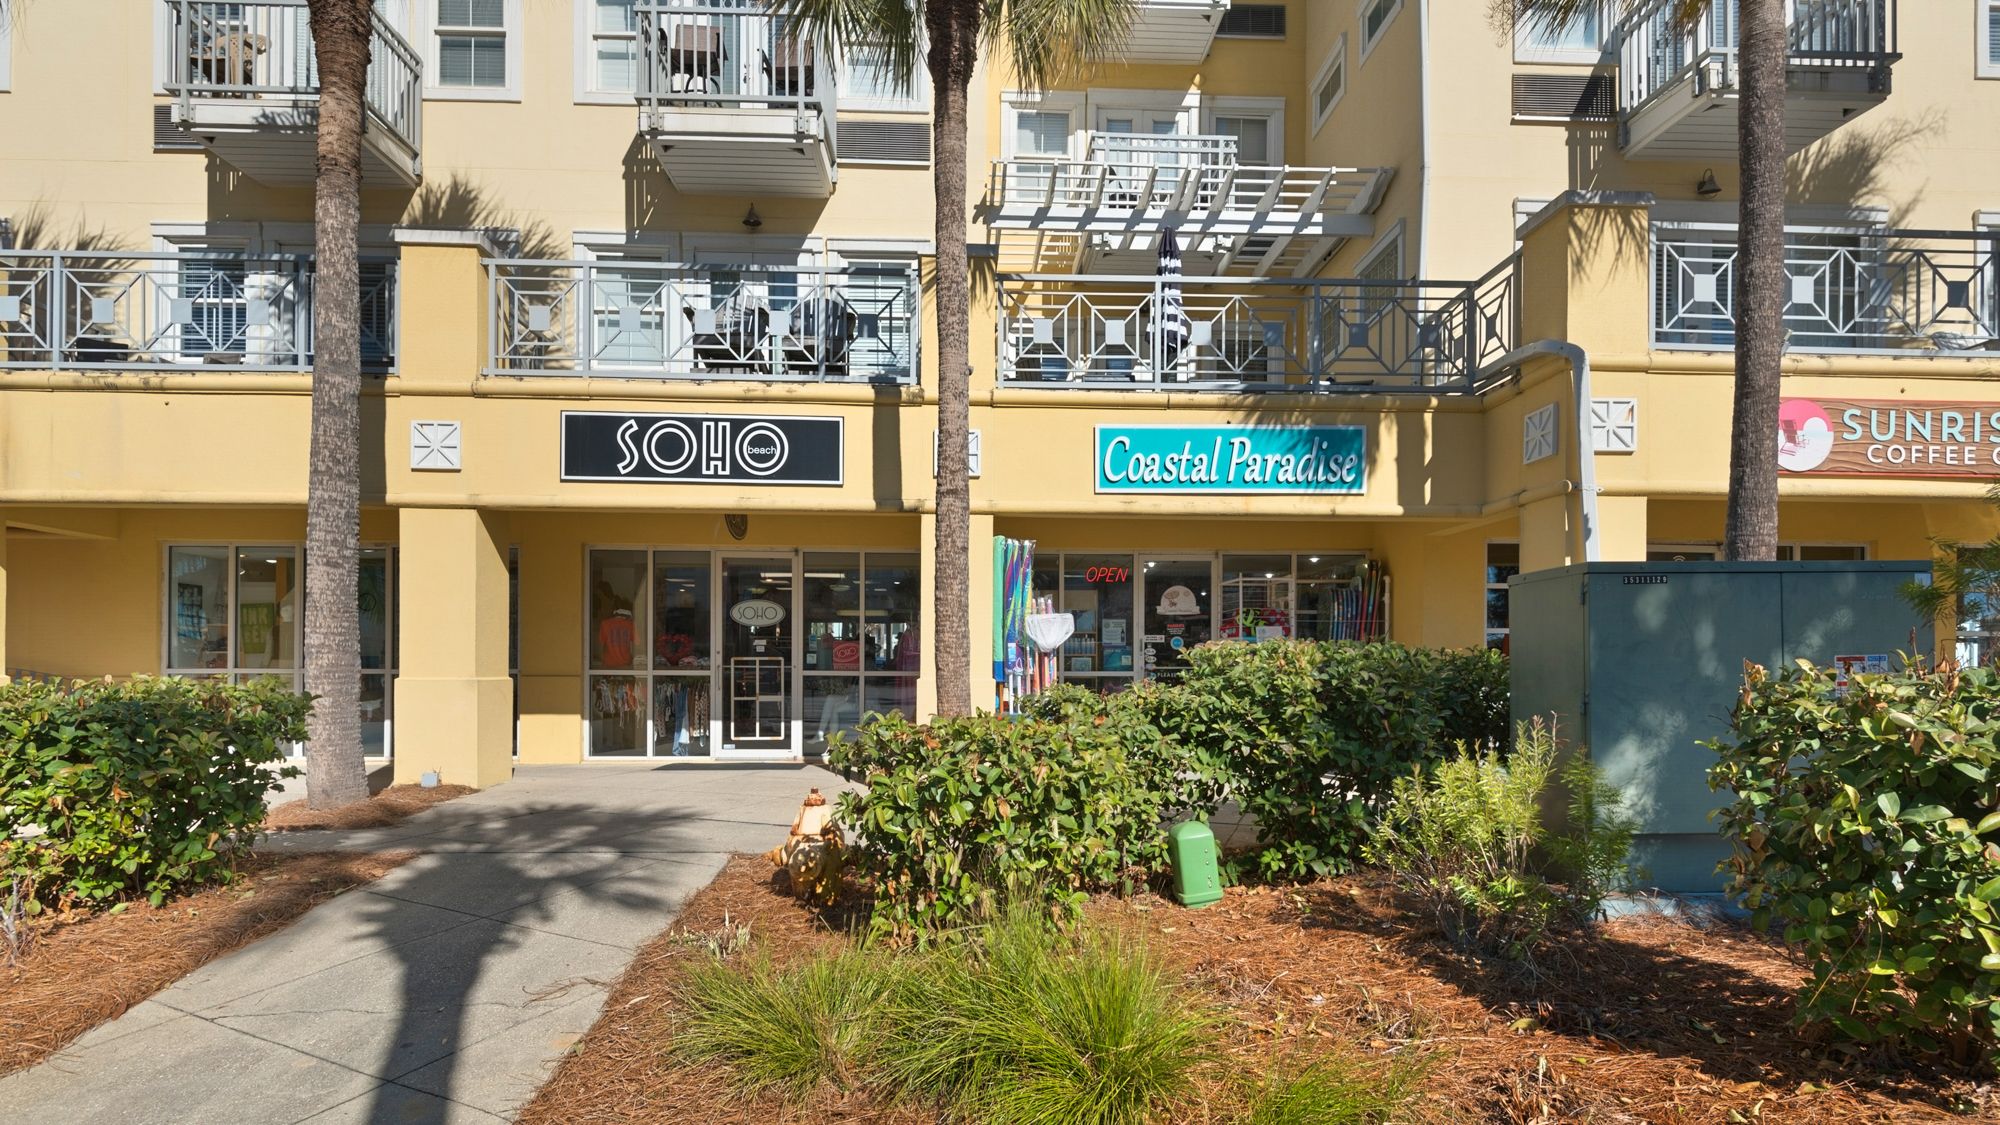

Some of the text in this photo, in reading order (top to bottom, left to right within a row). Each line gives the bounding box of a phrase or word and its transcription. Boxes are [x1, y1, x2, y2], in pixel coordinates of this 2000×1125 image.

[616, 418, 789, 476] SOHO
[747, 445, 777, 455] beach
[1867, 444, 1977, 465] COFFEE
[1103, 435, 1358, 483] Coastal Paradise
[1085, 566, 1129, 583] OPEN
[737, 606, 777, 620] SOHO
